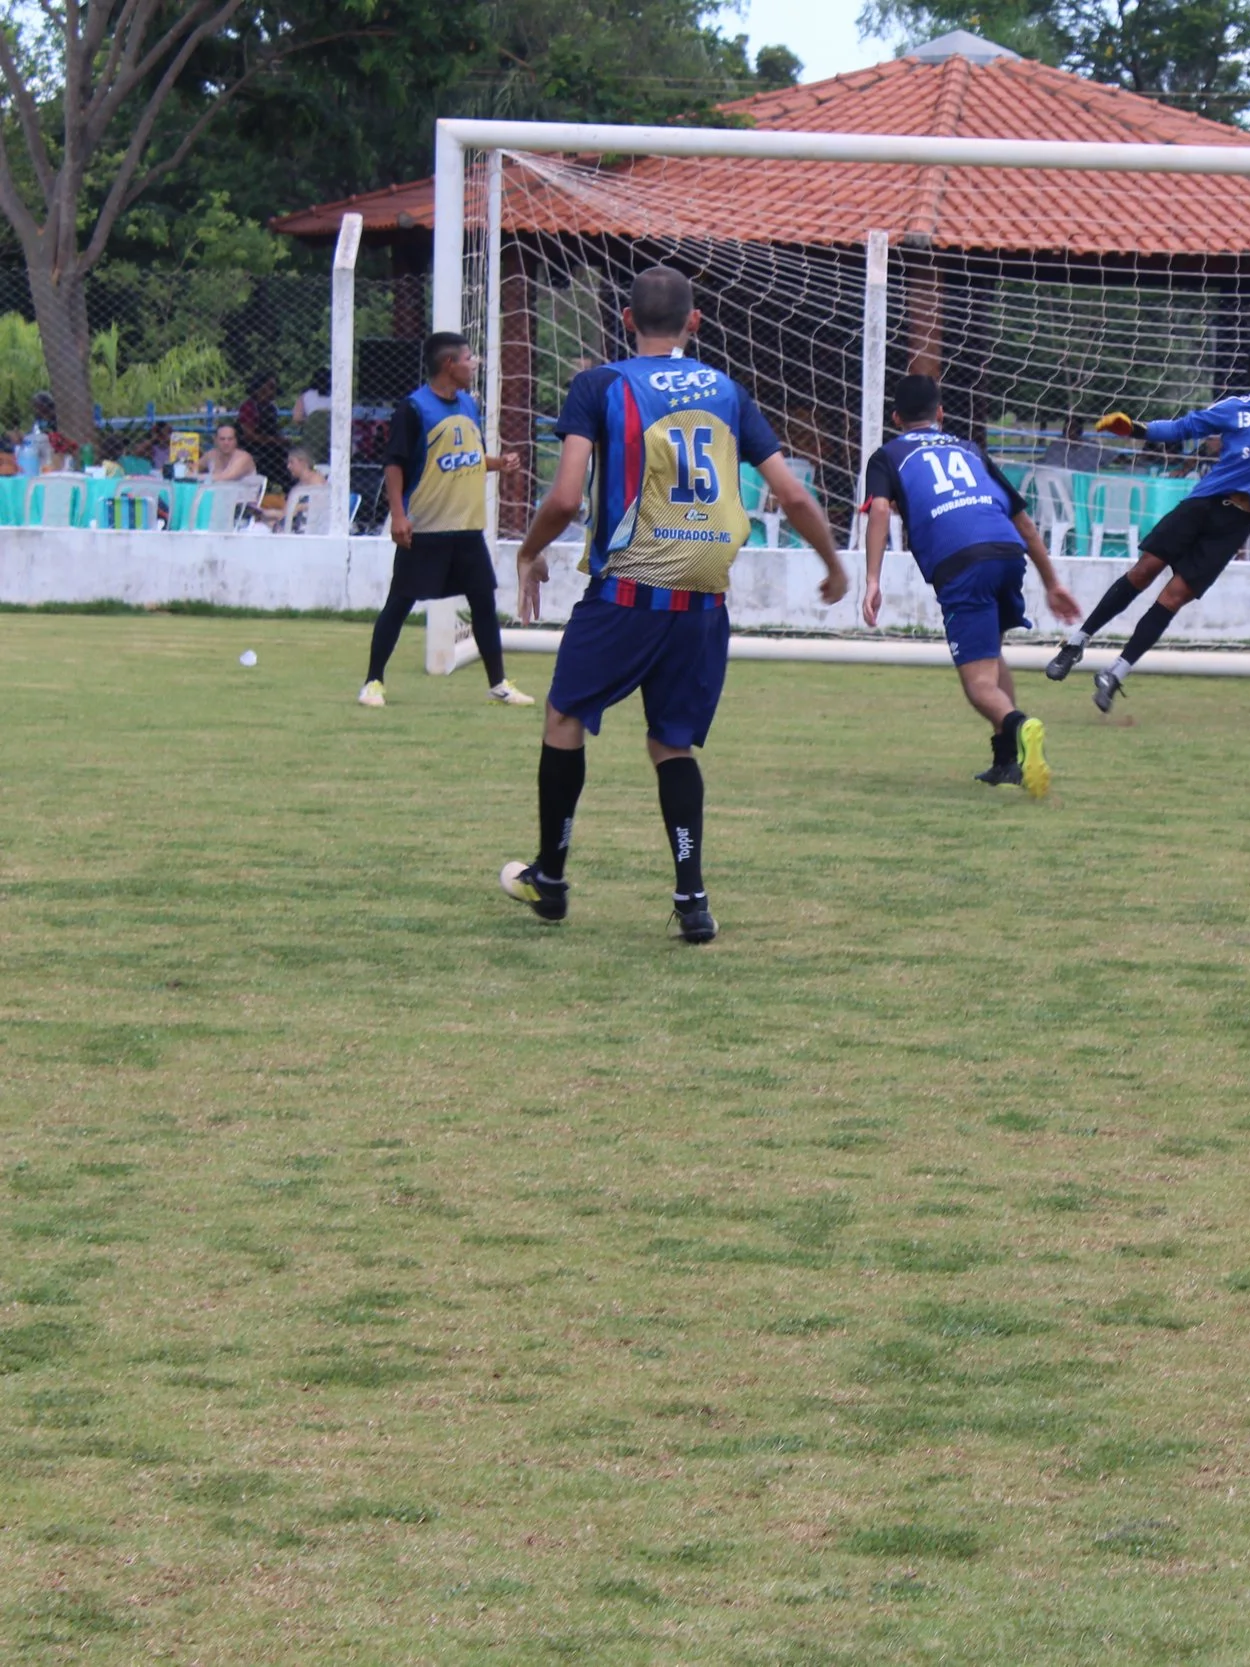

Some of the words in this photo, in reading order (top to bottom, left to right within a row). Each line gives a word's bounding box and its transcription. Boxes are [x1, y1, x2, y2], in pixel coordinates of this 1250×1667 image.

[667, 426, 721, 504] 15
[922, 451, 978, 495] 14
[930, 495, 993, 519] DOURADOS-MS
[653, 527, 732, 543] DOURADOS-MS
[676, 826, 694, 862] Topper
